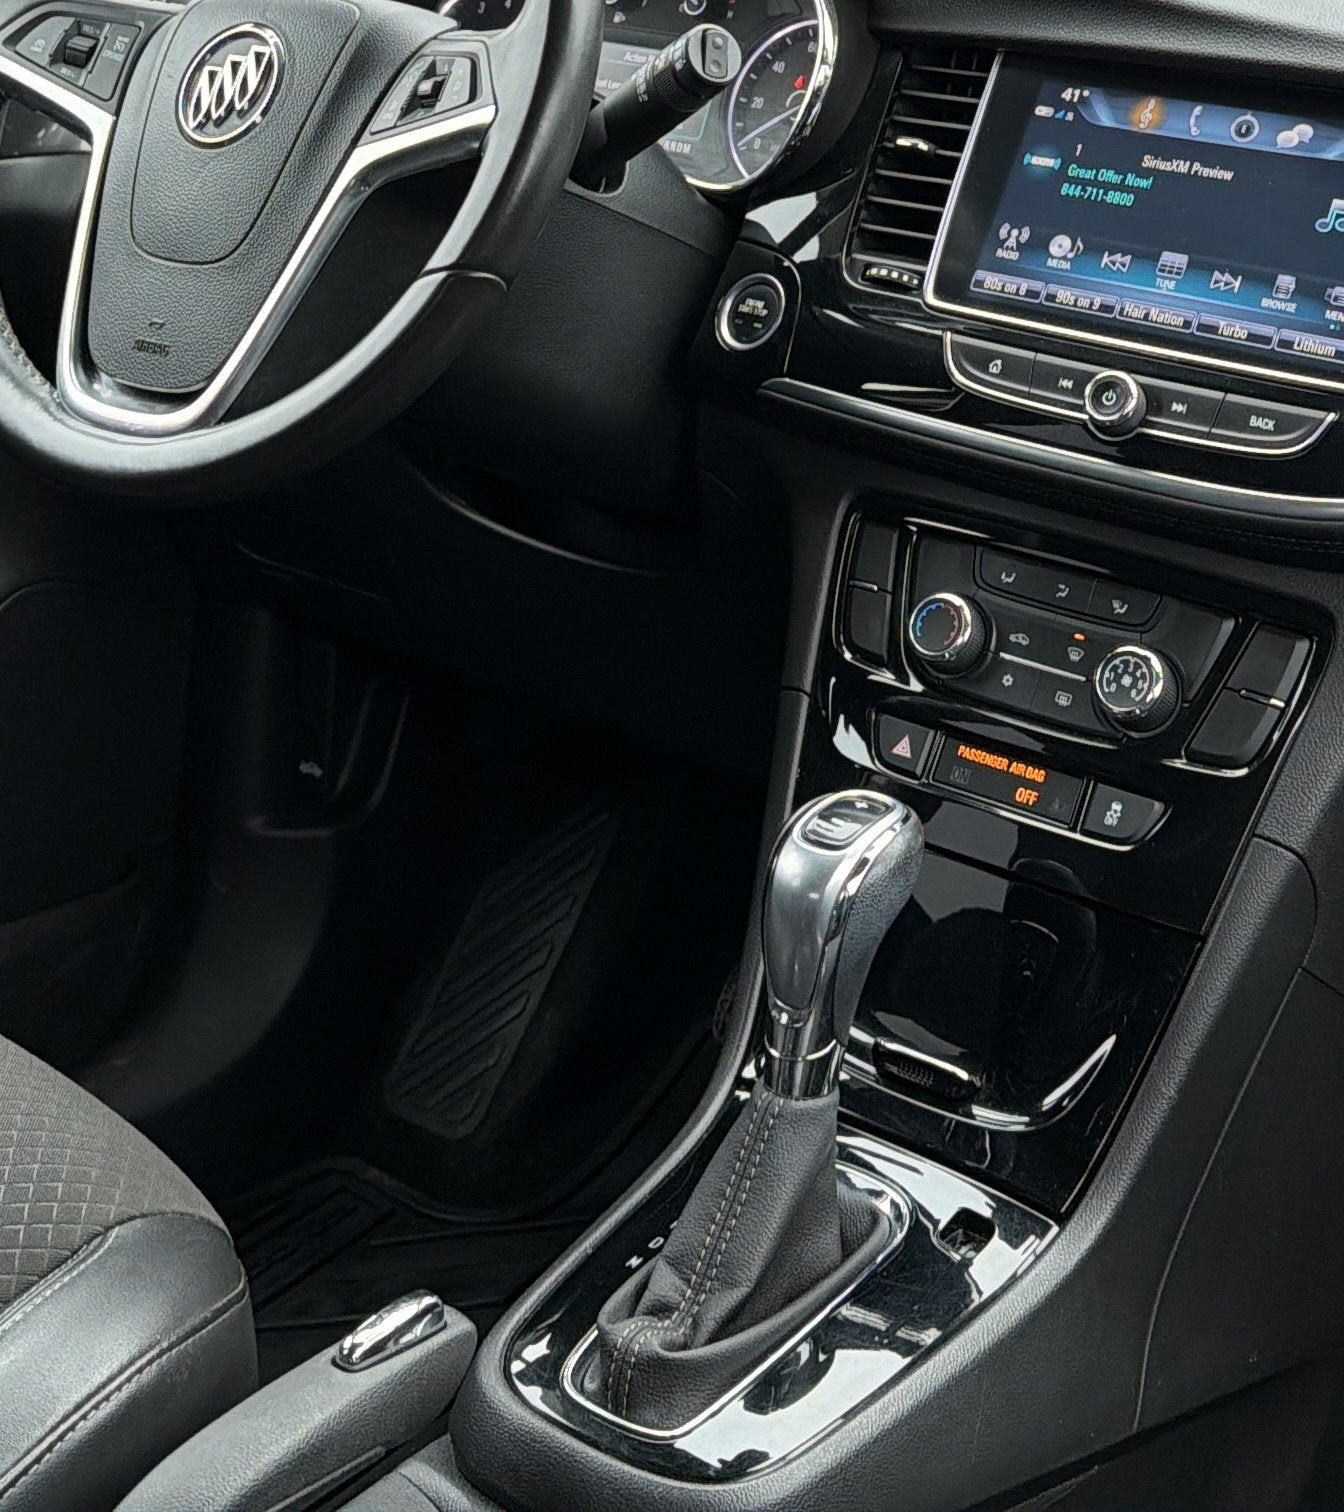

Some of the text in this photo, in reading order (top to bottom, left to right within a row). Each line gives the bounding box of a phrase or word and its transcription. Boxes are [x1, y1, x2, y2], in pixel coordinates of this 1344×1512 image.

[772, 61, 786, 74] 40
[751, 96, 764, 109] 20
[1067, 163, 1154, 189] Great Offer Now!
[1141, 154, 1235, 182] SiriusXM Preview
[995, 248, 1020, 261] RADIO
[1046, 257, 1072, 271] MEDIA
[983, 276, 1003, 291] 80s
[1018, 282, 1029, 296] 8
[1156, 277, 1177, 291] TUNE
[1055, 290, 1102, 311] 90s on 9
[1260, 297, 1298, 314] BROWSE
[1123, 302, 1185, 328] Hair Nation
[1217, 320, 1248, 340] Turbo
[1293, 337, 1337, 358] Lithium
[1249, 415, 1276, 432] BACK
[957, 744, 1048, 784] PASSENGER AIR BAG
[1015, 787, 1041, 807] OFF
